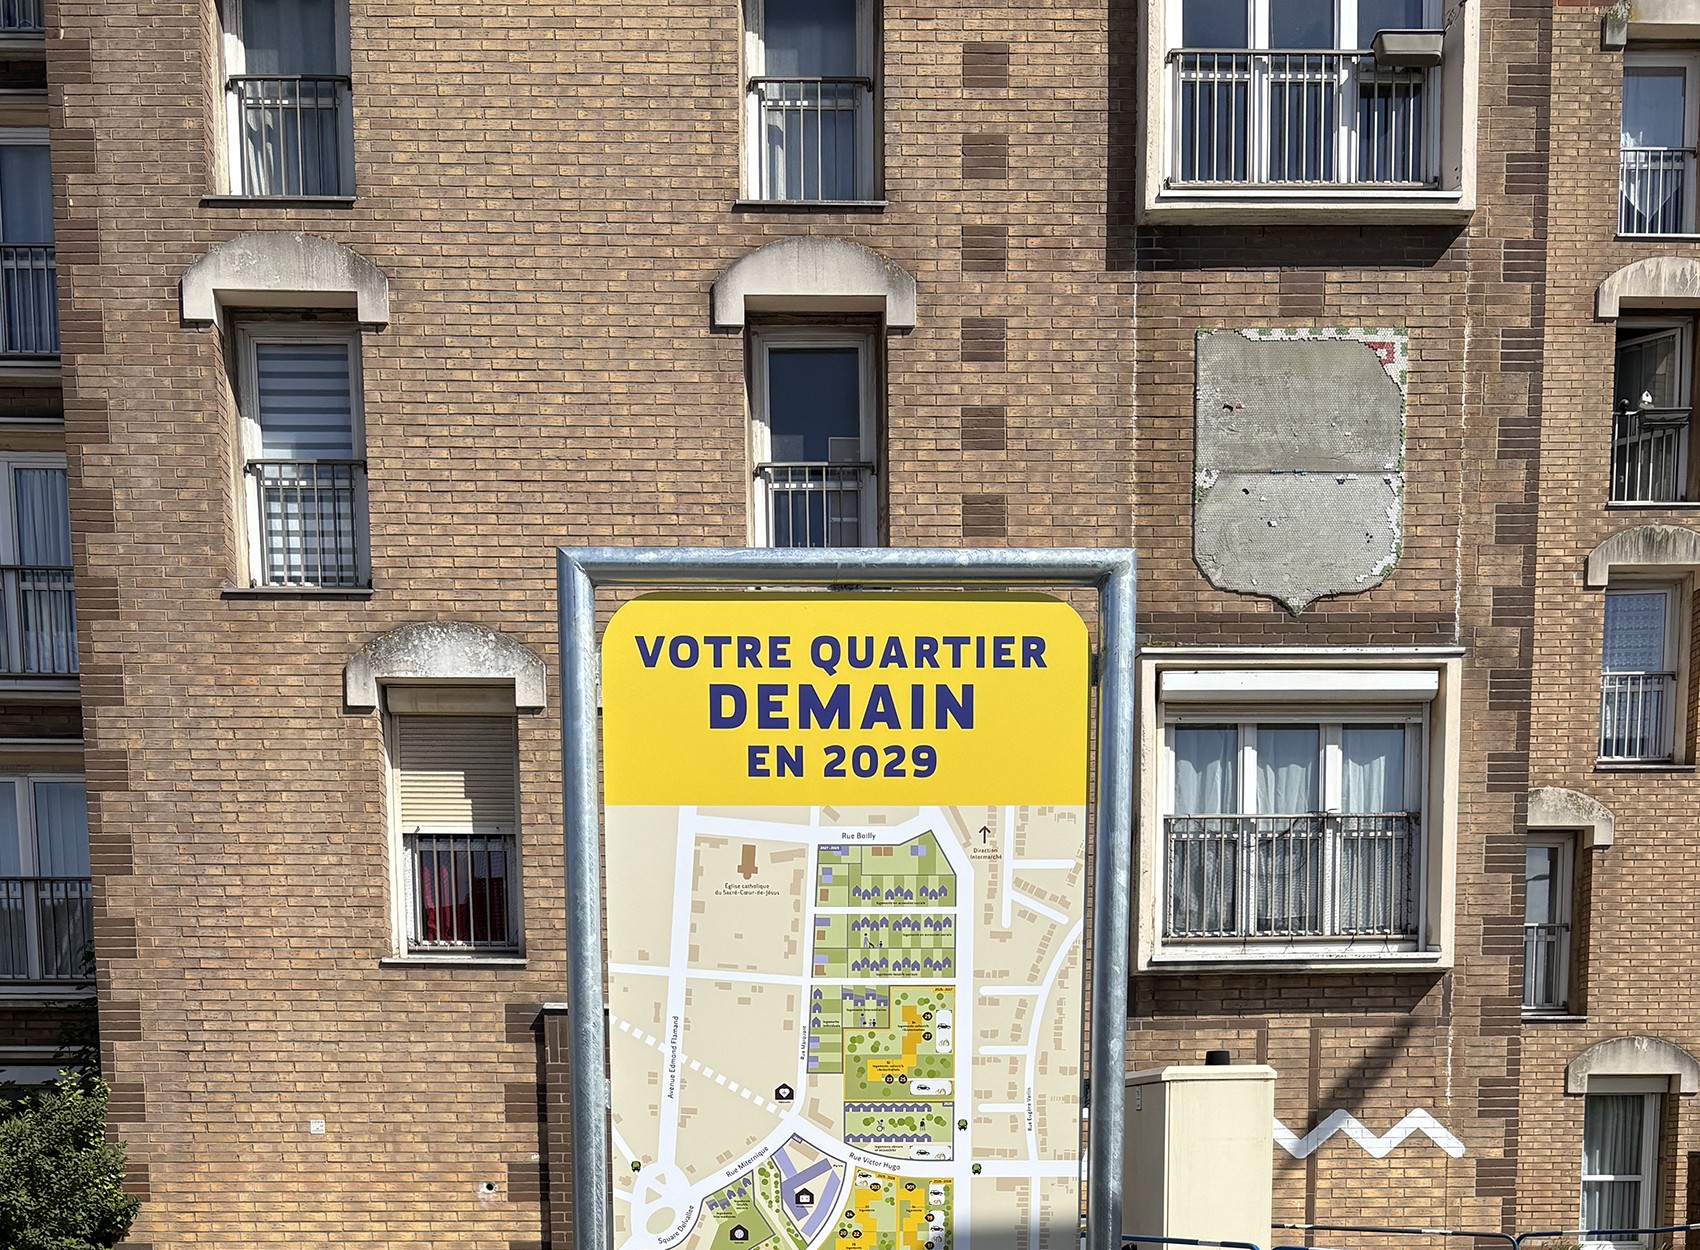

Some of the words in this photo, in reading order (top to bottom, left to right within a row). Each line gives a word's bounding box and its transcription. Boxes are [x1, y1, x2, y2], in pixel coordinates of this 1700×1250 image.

[634, 635, 791, 669] VOTRE
[810, 635, 1048, 676] QUARTIER
[708, 683, 975, 730] DEMAIN
[747, 745, 804, 778] EN
[823, 744, 939, 779] 2029
[856, 832, 876, 841] Boilly
[725, 882, 741, 890] Église
[671, 1016, 679, 1044] Flamand
[669, 1046, 677, 1073] Edmond
[726, 1167, 738, 1178] Rue
[849, 1152, 862, 1161] Rue
[863, 1157, 882, 1167] Victor
[883, 1162, 901, 1171] Hugo
[658, 1231, 680, 1245] Square
